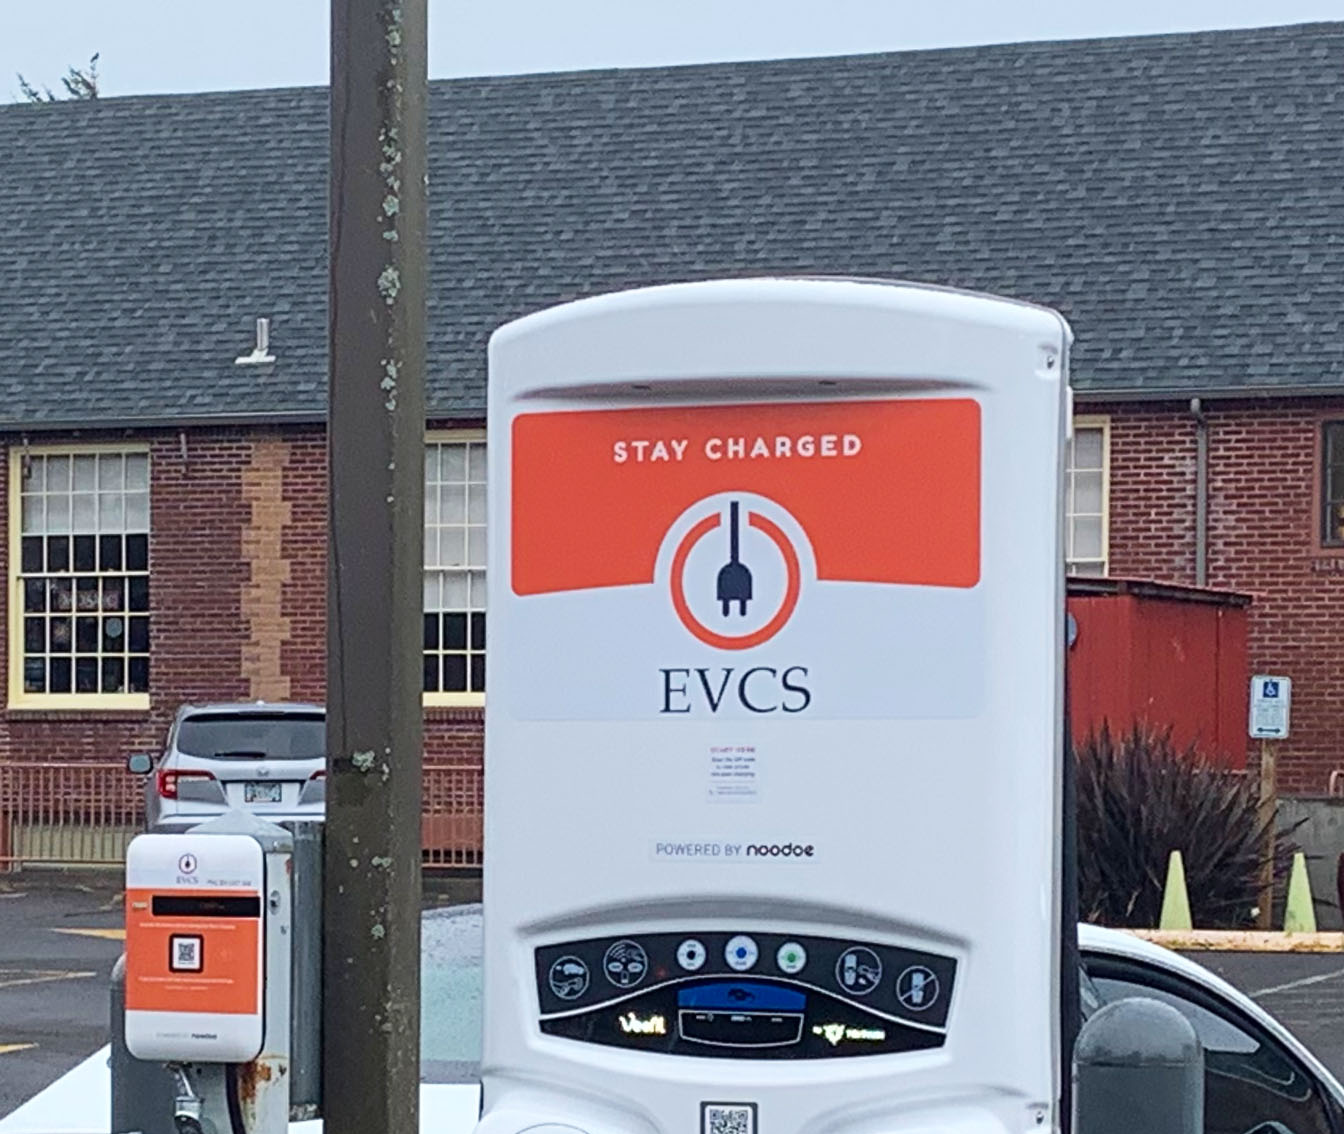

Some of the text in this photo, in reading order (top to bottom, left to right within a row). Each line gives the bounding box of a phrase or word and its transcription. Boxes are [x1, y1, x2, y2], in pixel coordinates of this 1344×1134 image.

[613, 434, 862, 463] STAY CHARGED
[658, 666, 812, 715] EVCS
[656, 843, 814, 857] POWERED BY noodoe
